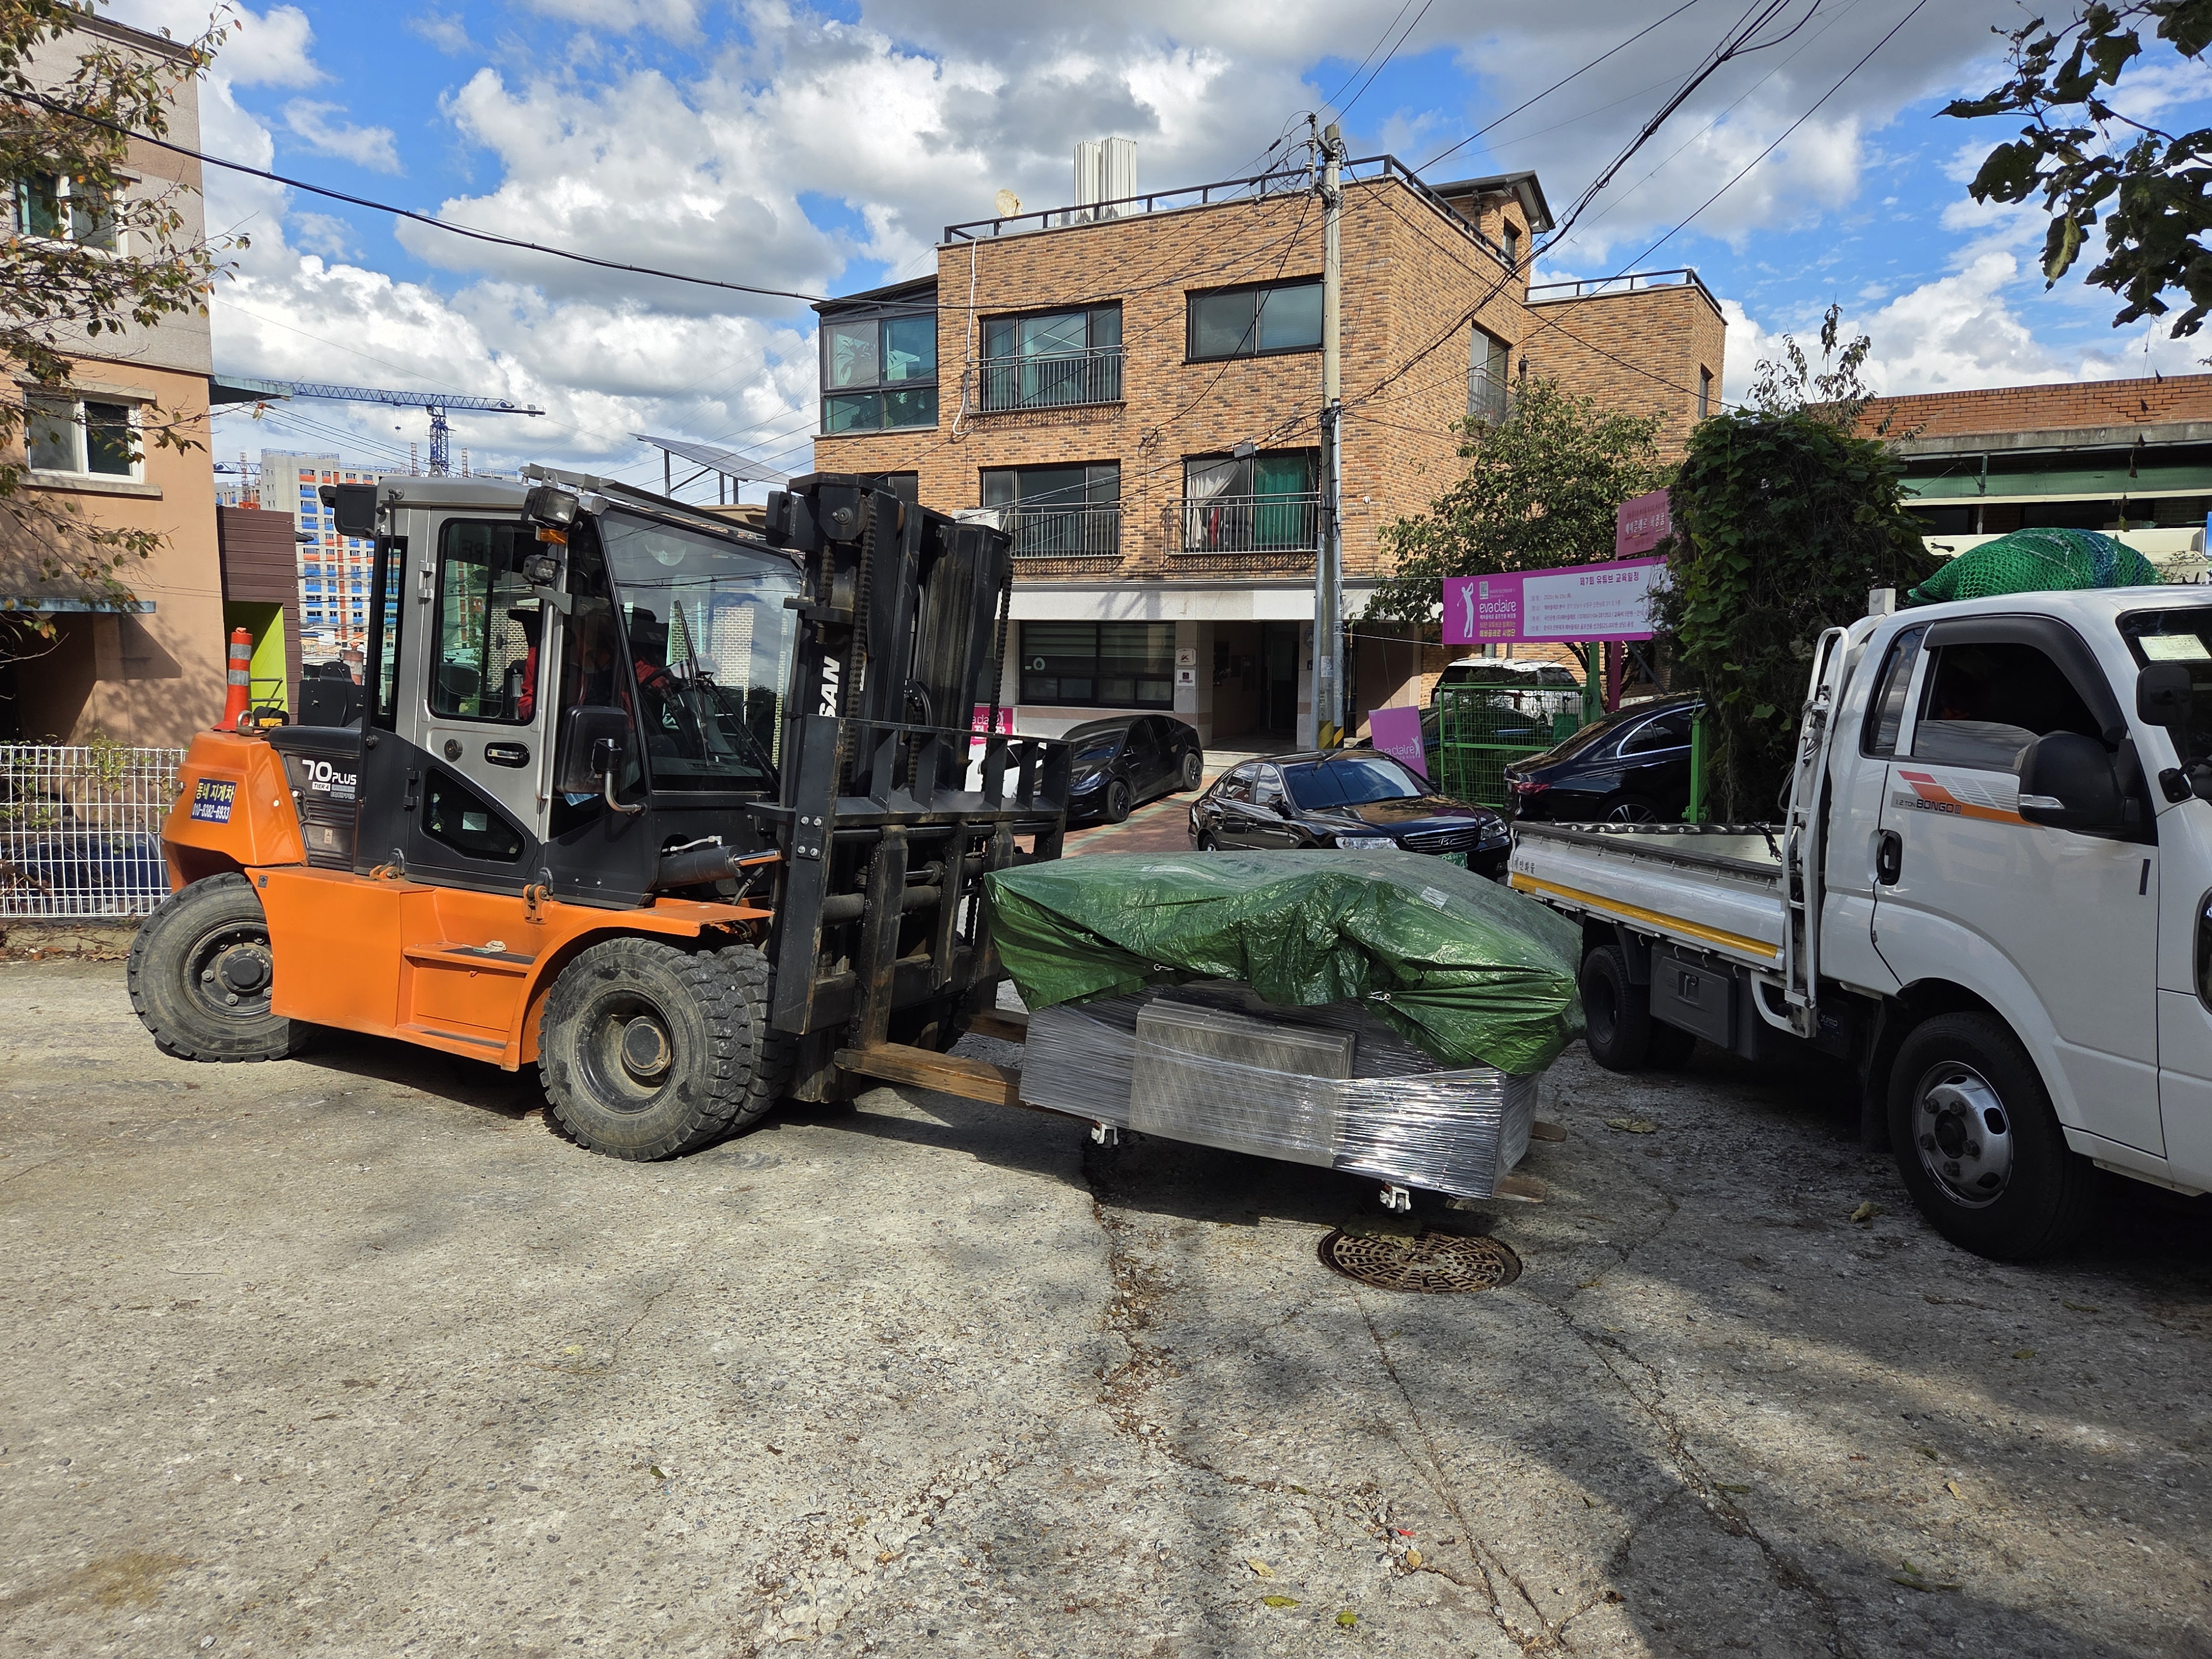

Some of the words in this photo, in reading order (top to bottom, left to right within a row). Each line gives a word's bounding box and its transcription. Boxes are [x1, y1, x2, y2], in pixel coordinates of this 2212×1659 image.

[1580, 576, 1594, 586] 제7회
[1597, 575, 1613, 585] 유튜브
[1616, 571, 1639, 582] 교육일정
[196, 782, 211, 800] 동네
[210, 784, 234, 803] 지게차
[1916, 799, 1954, 813] BONGO
